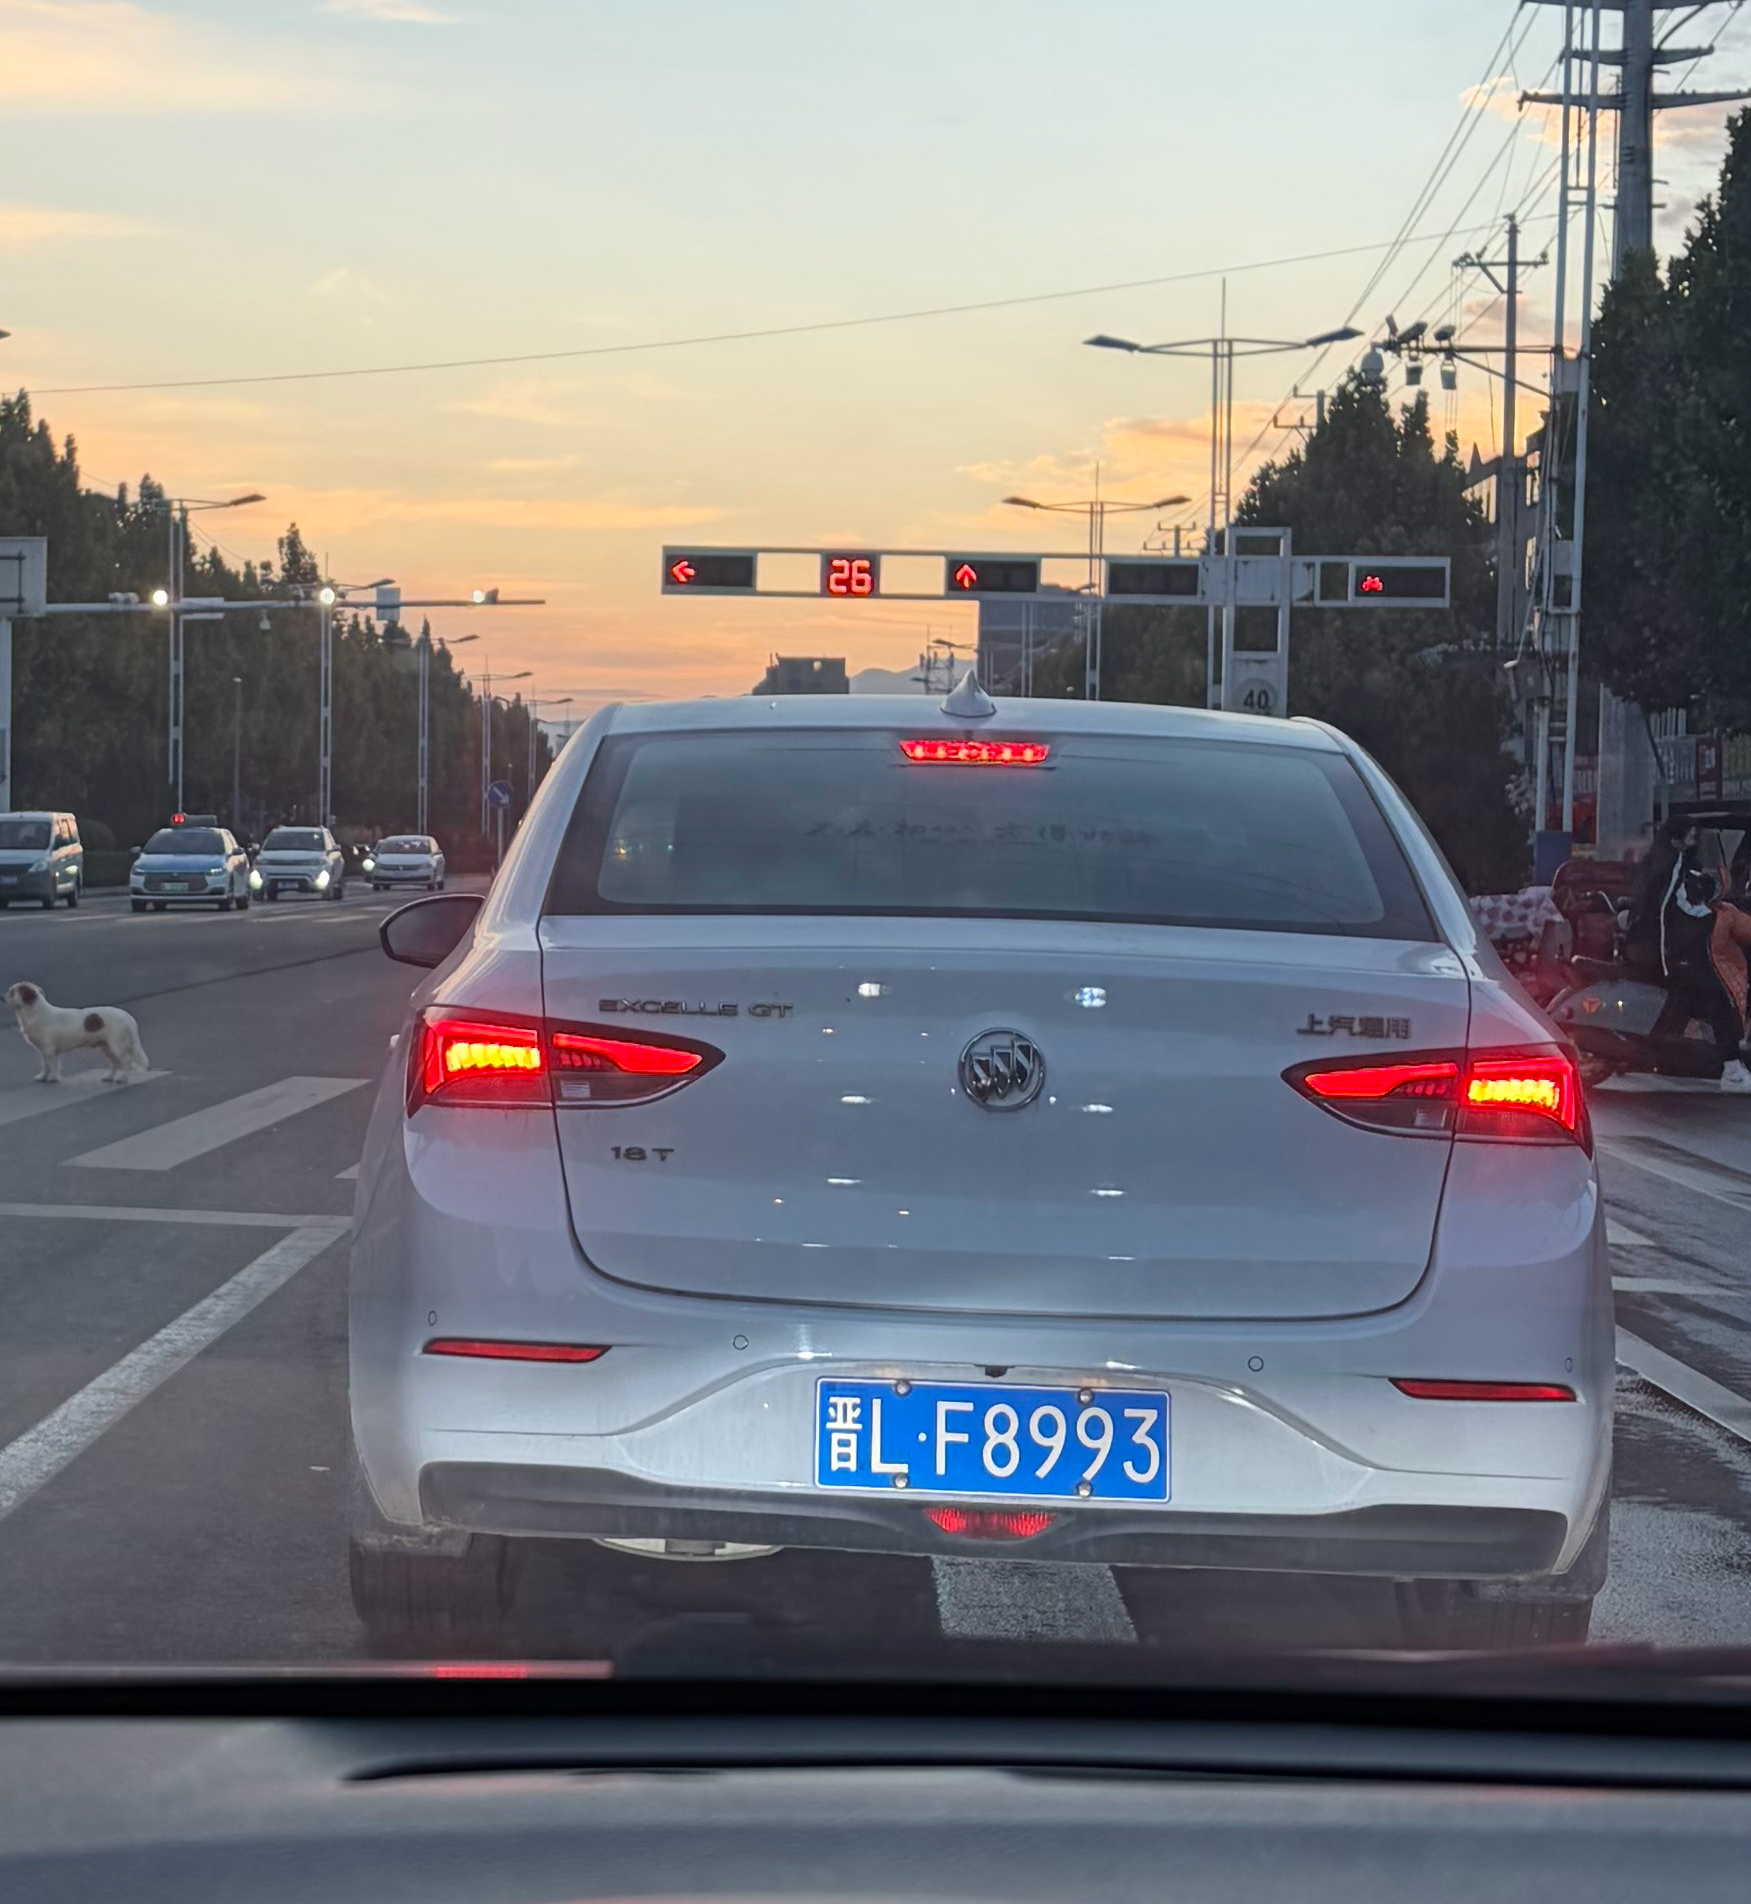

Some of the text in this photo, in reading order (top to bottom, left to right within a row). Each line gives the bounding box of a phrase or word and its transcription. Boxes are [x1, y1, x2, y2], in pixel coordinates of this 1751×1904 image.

[829, 559, 872, 594] 26
[1243, 689, 1270, 710] 40
[599, 998, 793, 1018] EXCELLE GT
[1296, 1013, 1411, 1040] 上汽通用
